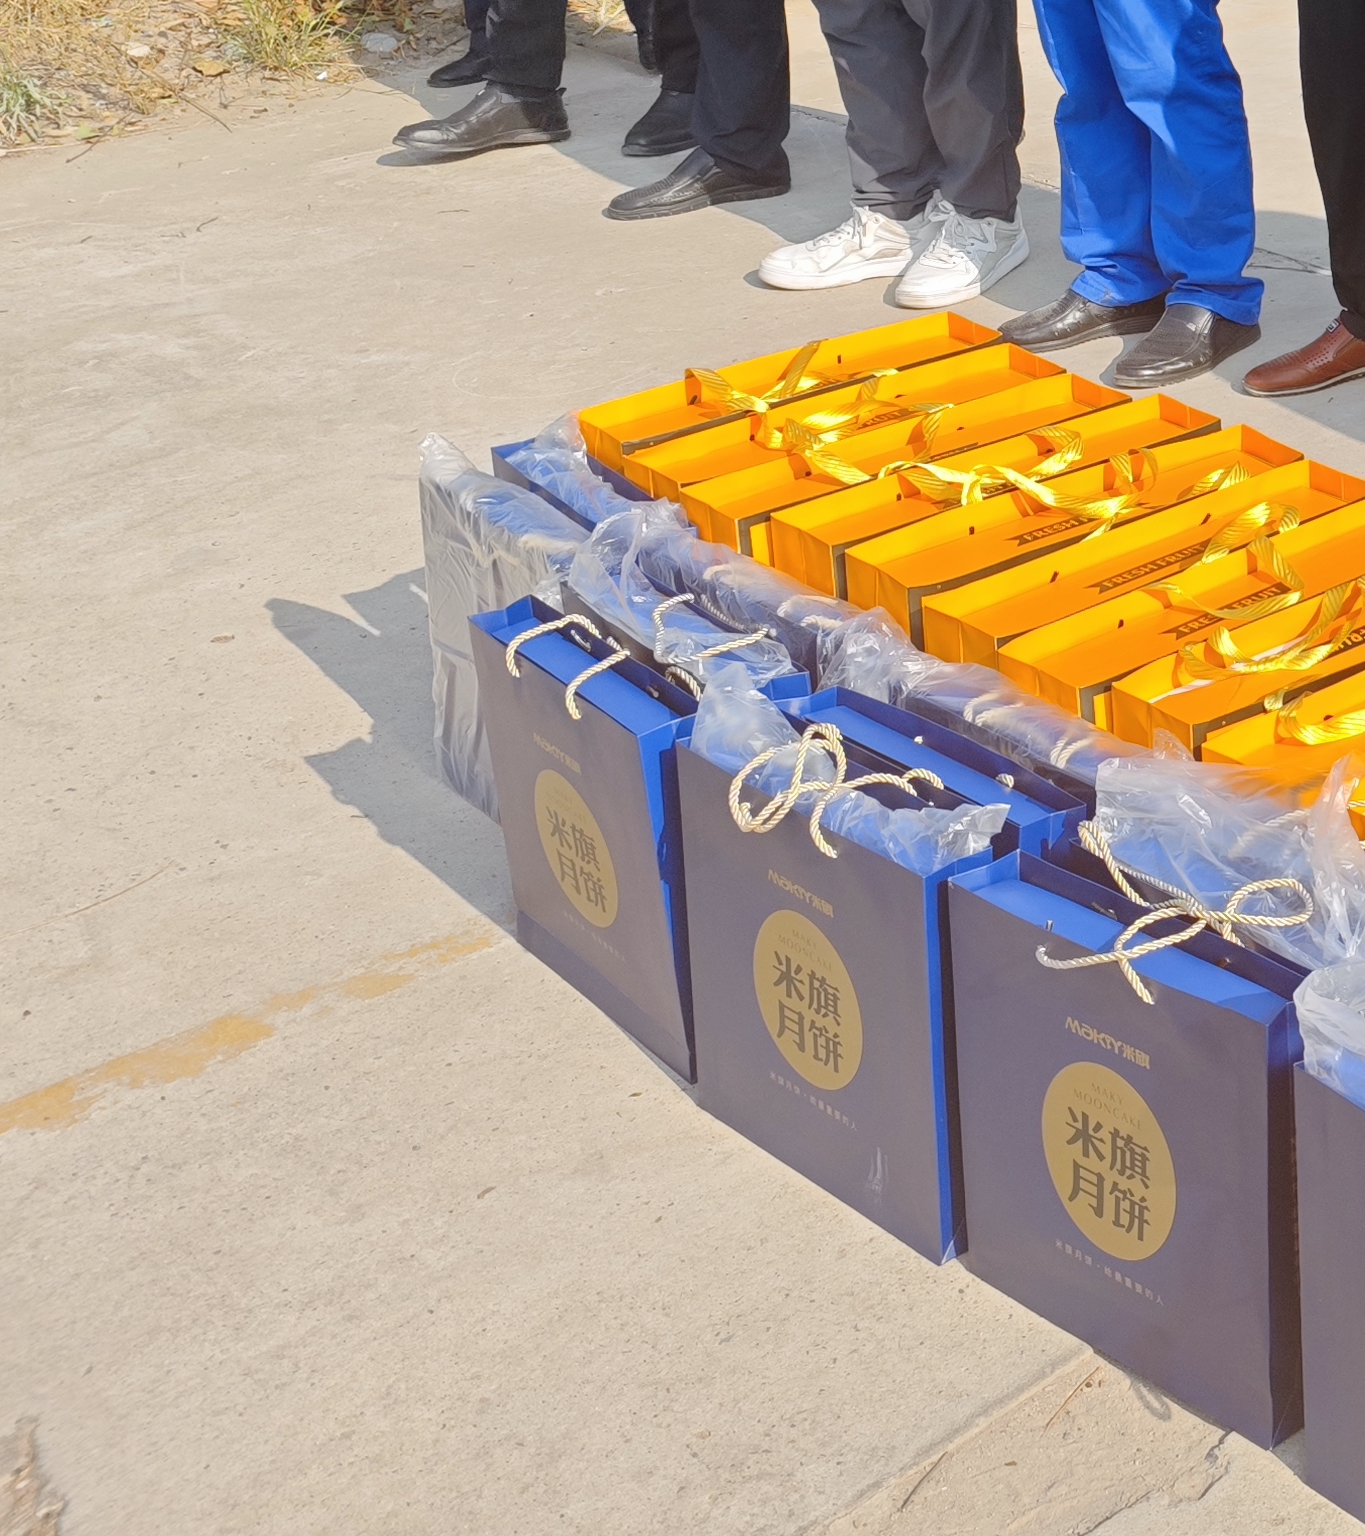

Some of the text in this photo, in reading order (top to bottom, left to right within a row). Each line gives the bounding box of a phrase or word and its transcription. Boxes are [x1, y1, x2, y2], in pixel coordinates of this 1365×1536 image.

[1022, 516, 1079, 542] FRESH
[1101, 544, 1206, 589] FRESH FRUIT
[1177, 611, 1218, 636] FRES
[546, 805, 602, 873] 米旗
[556, 847, 608, 914] 月饼
[772, 950, 843, 1028] 米旗
[775, 998, 845, 1075] 月饼
[1072, 1087, 1144, 1133] MOONCAKE
[1090, 1081, 1125, 1108] MAKY
[1064, 1105, 1151, 1191] 米旗
[1066, 1158, 1152, 1243] 月饼
